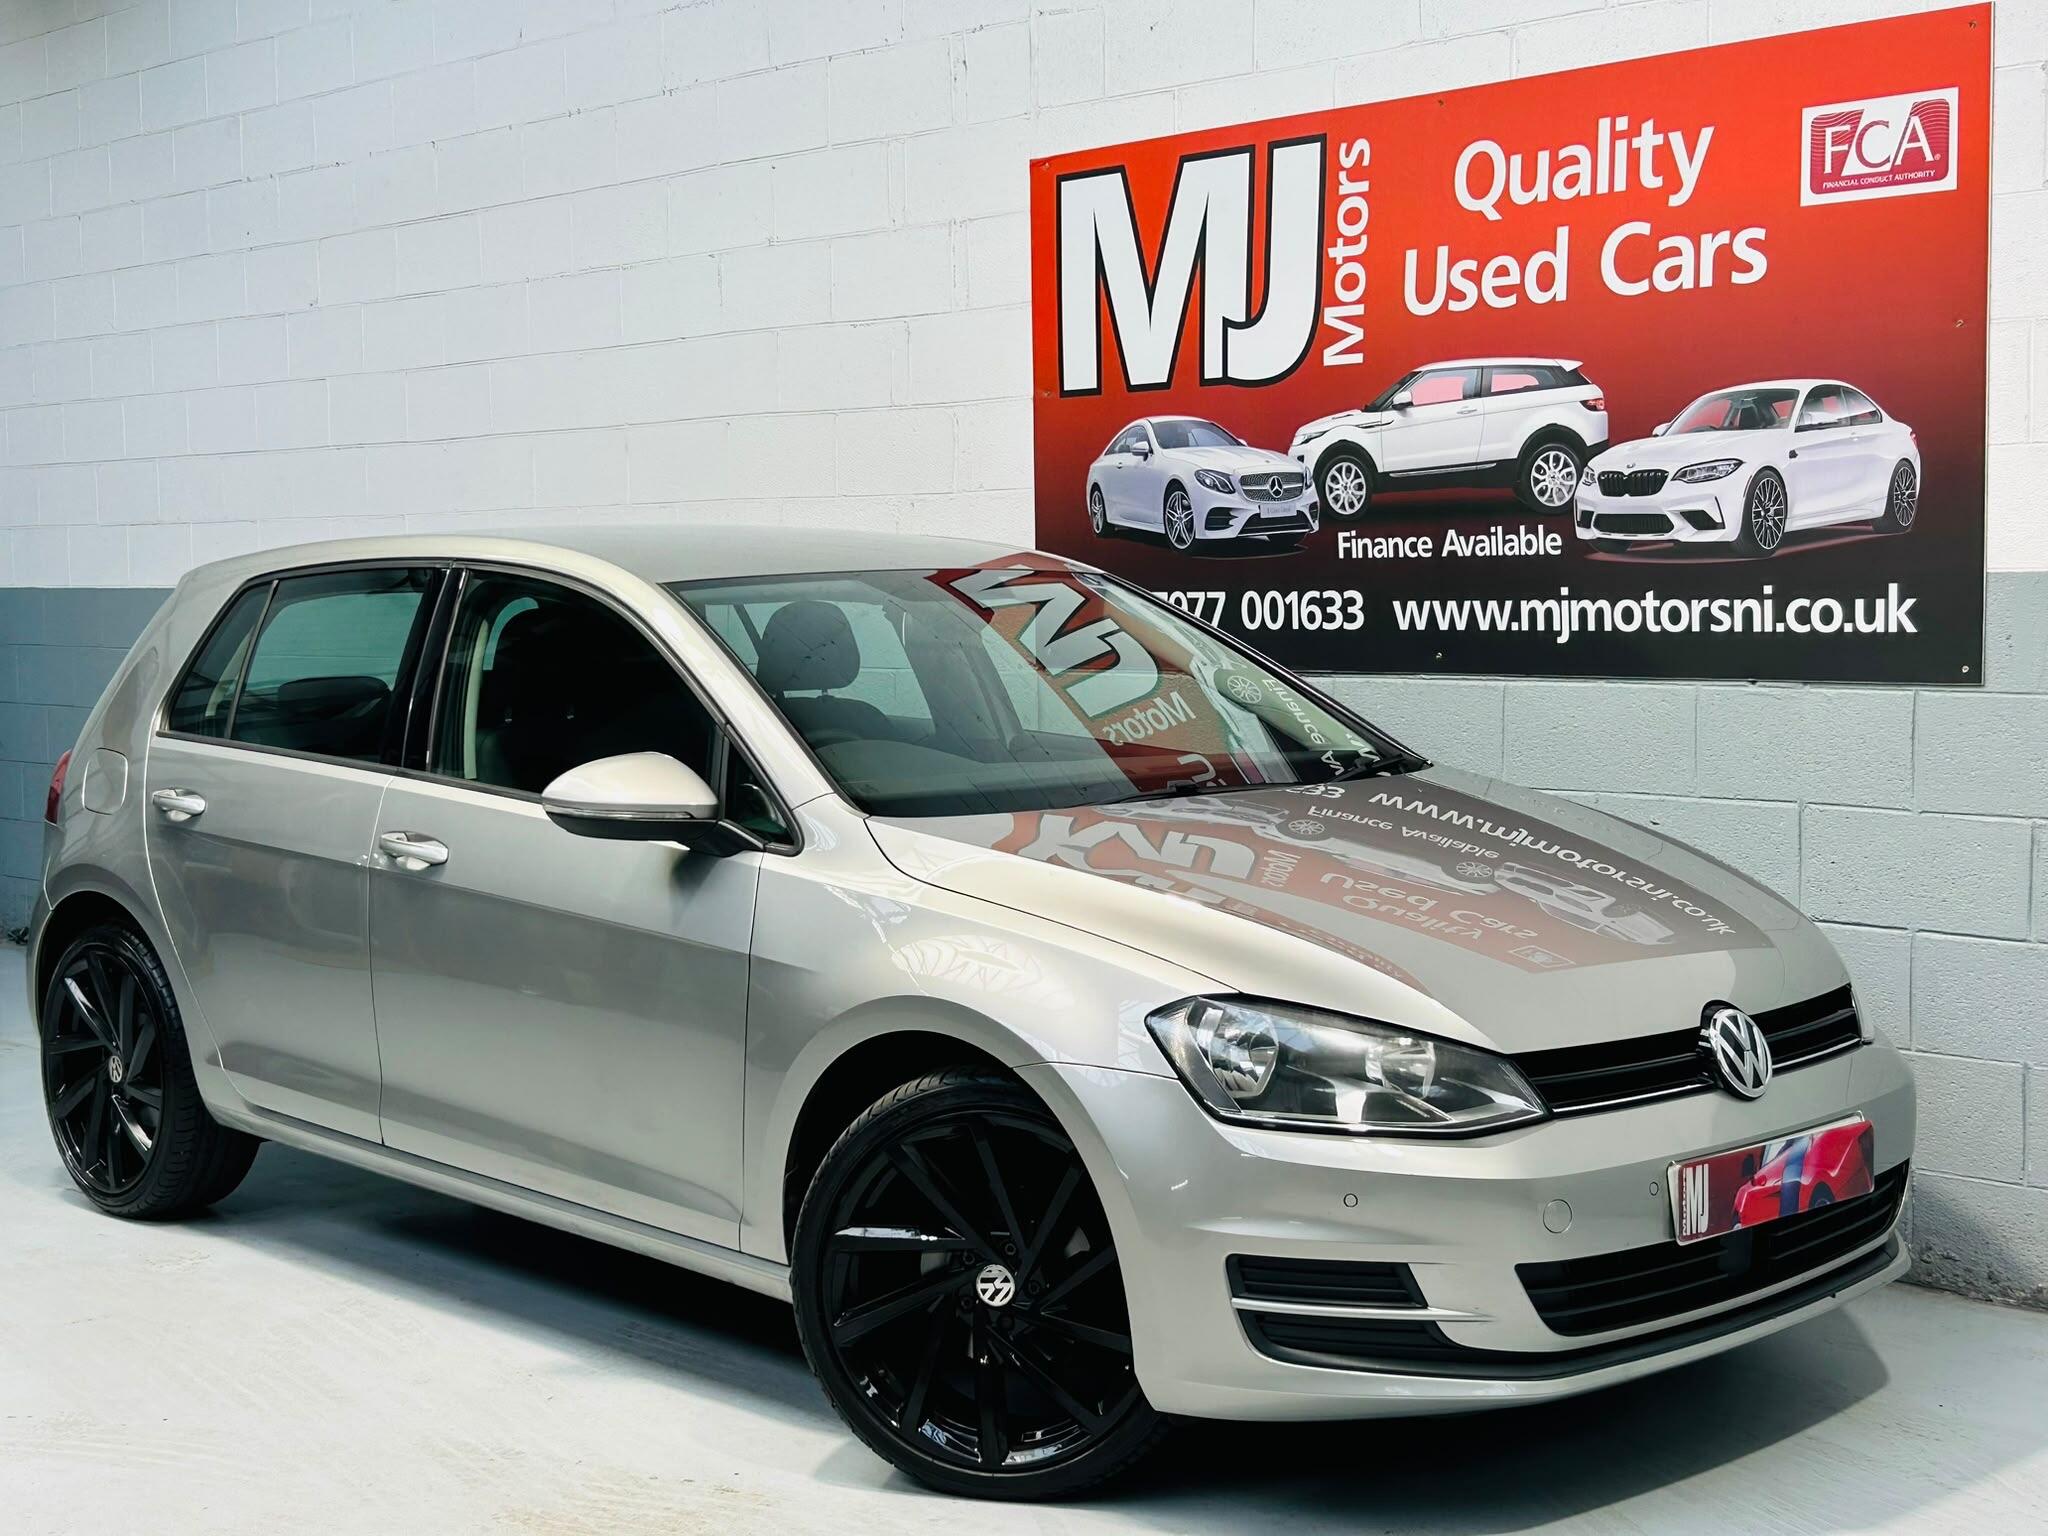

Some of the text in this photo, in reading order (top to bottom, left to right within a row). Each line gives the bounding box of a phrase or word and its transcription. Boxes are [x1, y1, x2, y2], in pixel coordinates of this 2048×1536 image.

[1454, 116, 1714, 219] Quality
[1824, 115, 1936, 174] FCA
[1823, 169, 1936, 190] FINANCIAL CONDUCT AUTHORITY
[1058, 135, 1327, 396] MJ
[1323, 138, 1371, 366] Motors
[1404, 221, 1768, 316] Used Cars
[1338, 528, 1562, 560] Finance Available
[1241, 590, 1365, 631] 001633
[1393, 585, 1918, 645] www.mjmotorsni.co.uk
[1686, 1163, 1709, 1236] MJ
